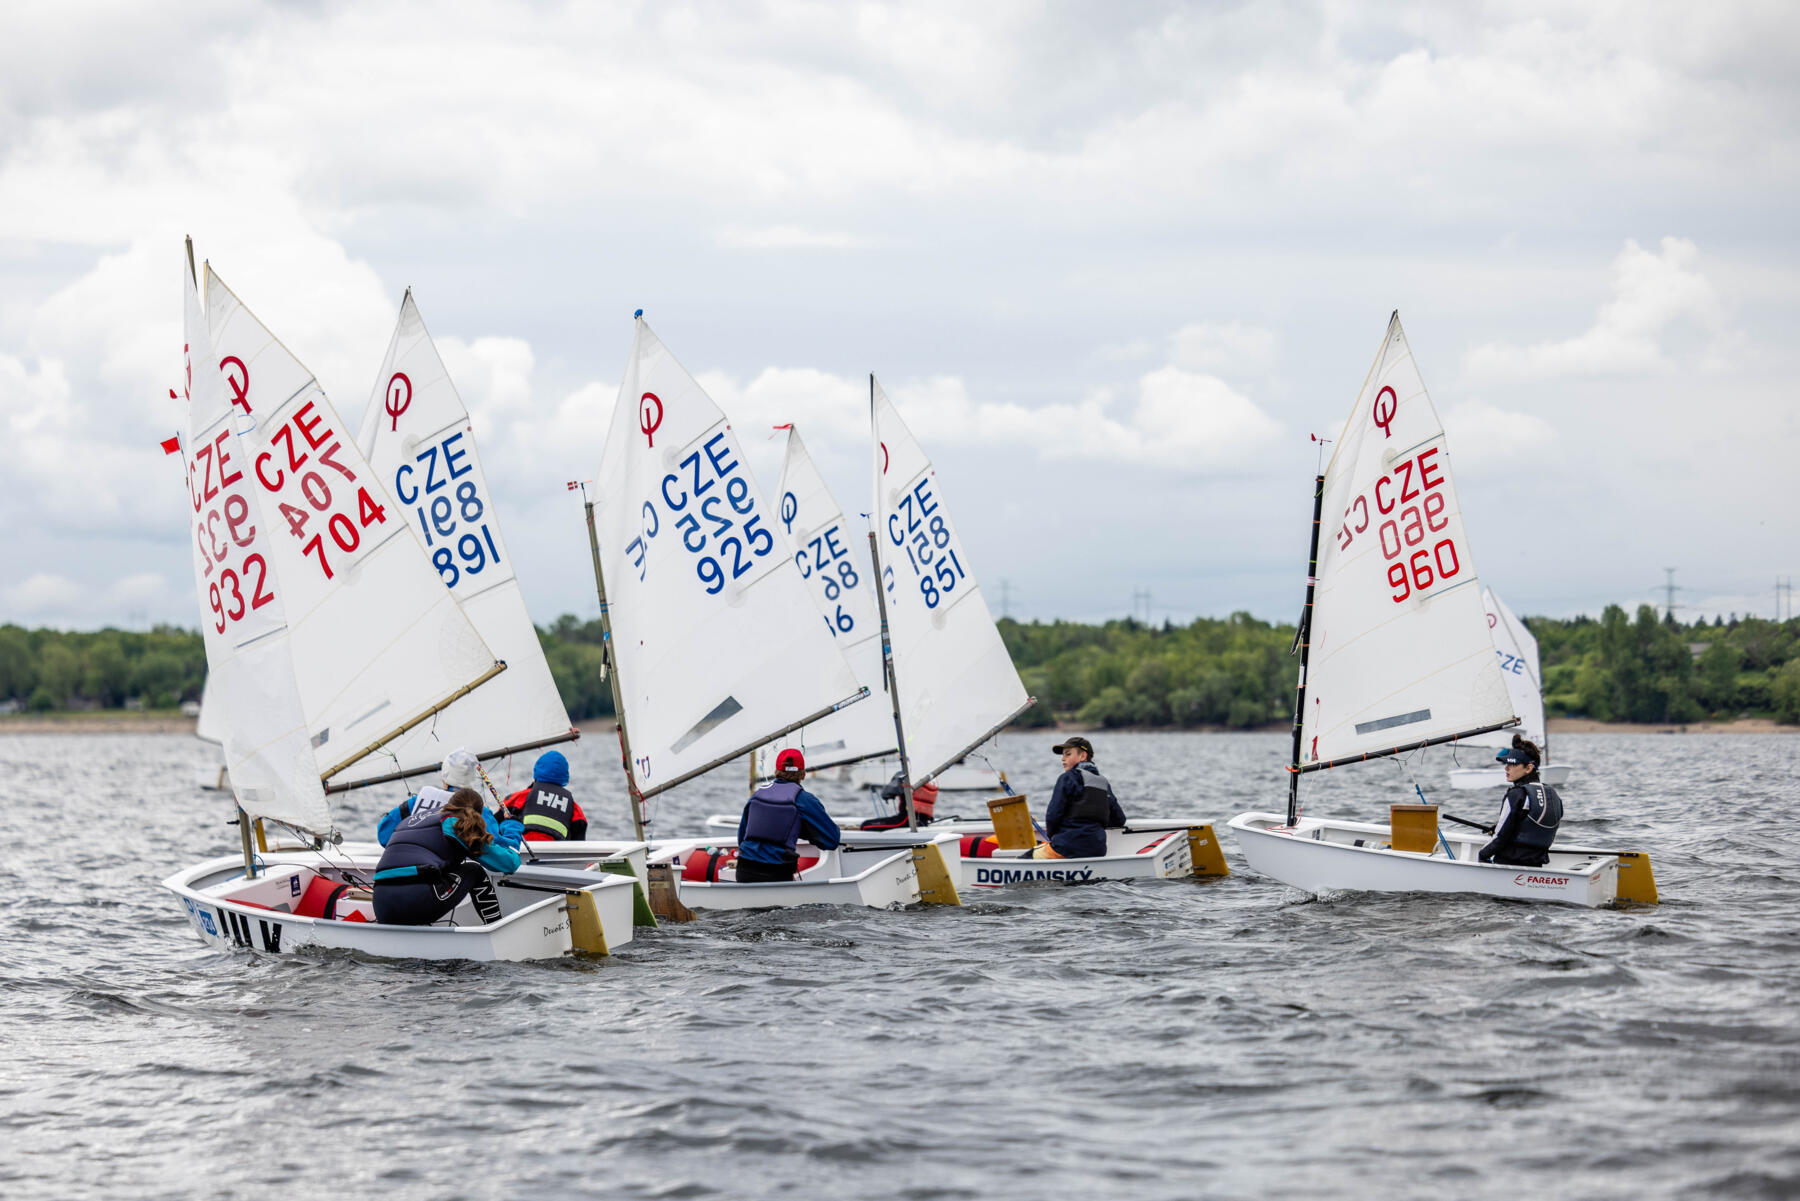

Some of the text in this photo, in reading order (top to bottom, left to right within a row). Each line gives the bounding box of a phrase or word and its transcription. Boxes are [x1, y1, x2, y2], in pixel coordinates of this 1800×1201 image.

[190, 429, 244, 513] CZE
[255, 400, 334, 492] CZE
[396, 432, 473, 505] CZE
[661, 431, 739, 512] CZE
[888, 477, 938, 546] CZE
[1374, 447, 1445, 515] CZE
[302, 486, 387, 580] 704
[432, 524, 501, 589] 891
[696, 514, 773, 595] 925
[795, 525, 848, 579] CZE
[209, 553, 275, 635] 932
[920, 548, 965, 609] 851
[1387, 538, 1460, 603] 960
[824, 604, 854, 638] 6
[1496, 650, 1526, 676] ZE
[536, 790, 568, 813] HH
[976, 865, 1093, 884] DOMANSKÝ
[1527, 875, 1570, 886] FAREAST
